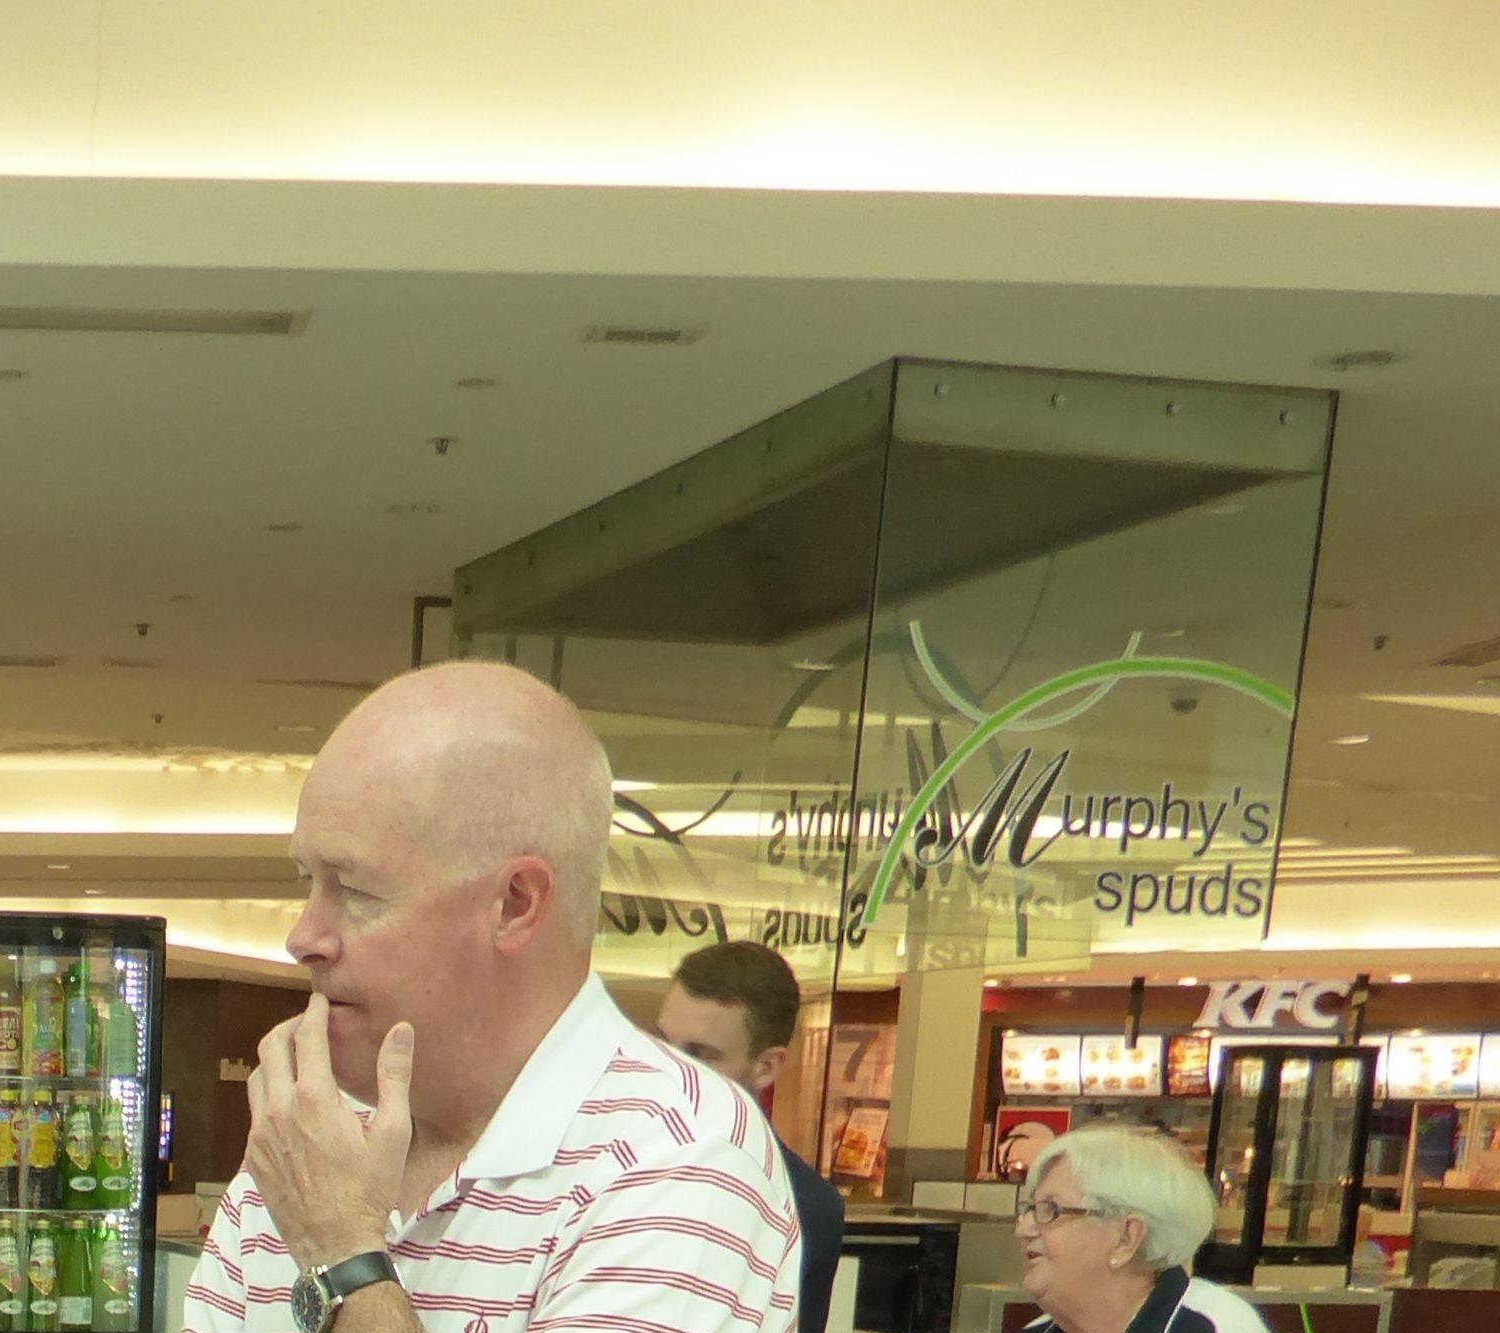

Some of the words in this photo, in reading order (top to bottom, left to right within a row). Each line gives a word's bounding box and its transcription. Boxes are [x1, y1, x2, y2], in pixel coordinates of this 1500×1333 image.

[914, 747, 1271, 868] Murphy's
[1094, 862, 1263, 927] spuds
[1193, 980, 1354, 1029] KFC
